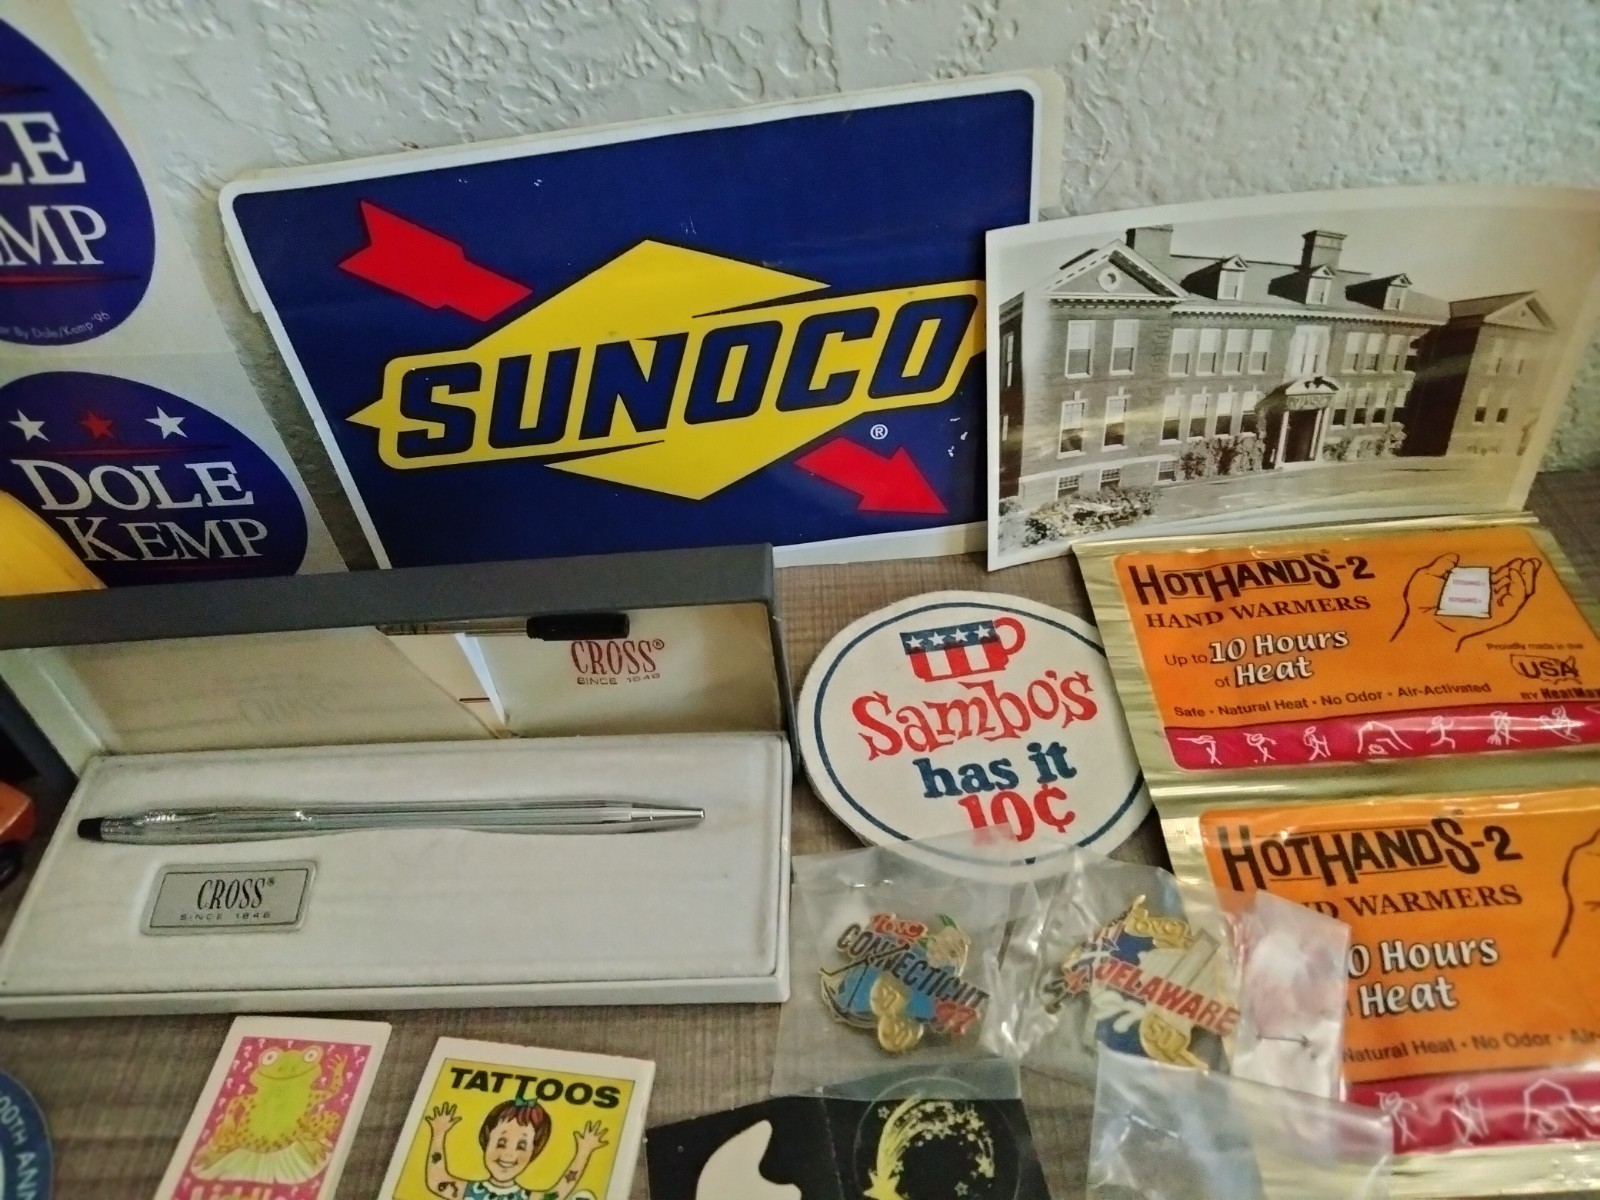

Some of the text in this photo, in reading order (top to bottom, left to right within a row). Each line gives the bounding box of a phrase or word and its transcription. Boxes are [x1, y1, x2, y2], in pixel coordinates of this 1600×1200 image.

[395, 293, 979, 459] SUNOCO
[10, 459, 255, 511] DOLE
[56, 517, 268, 562] KEMP
[1144, 595, 1372, 629] HAND WARMERS
[1163, 630, 1350, 667] Up to 10 Hours
[577, 677, 618, 685] SINCE
[1214, 655, 1315, 689] of Heat
[1518, 660, 1580, 680] USA
[852, 669, 1098, 761] Sambo's
[1174, 682, 1492, 719] Safe Natural Heat No Odor Air-Activated
[912, 741, 1078, 798] has it
[957, 784, 1076, 846] 10¢
[1345, 884, 1523, 918] WARMERS
[1347, 937, 1498, 979] 0 Hours
[1094, 957, 1241, 1037] DELAWARE
[1360, 975, 1458, 1019] Heat
[1343, 1042, 1409, 1063] Natural
[1412, 1038, 1458, 1055] Heat
[1471, 1035, 1499, 1050] No
[1502, 1031, 1551, 1048] Odor
[450, 1067, 621, 1109] TATTOOS
